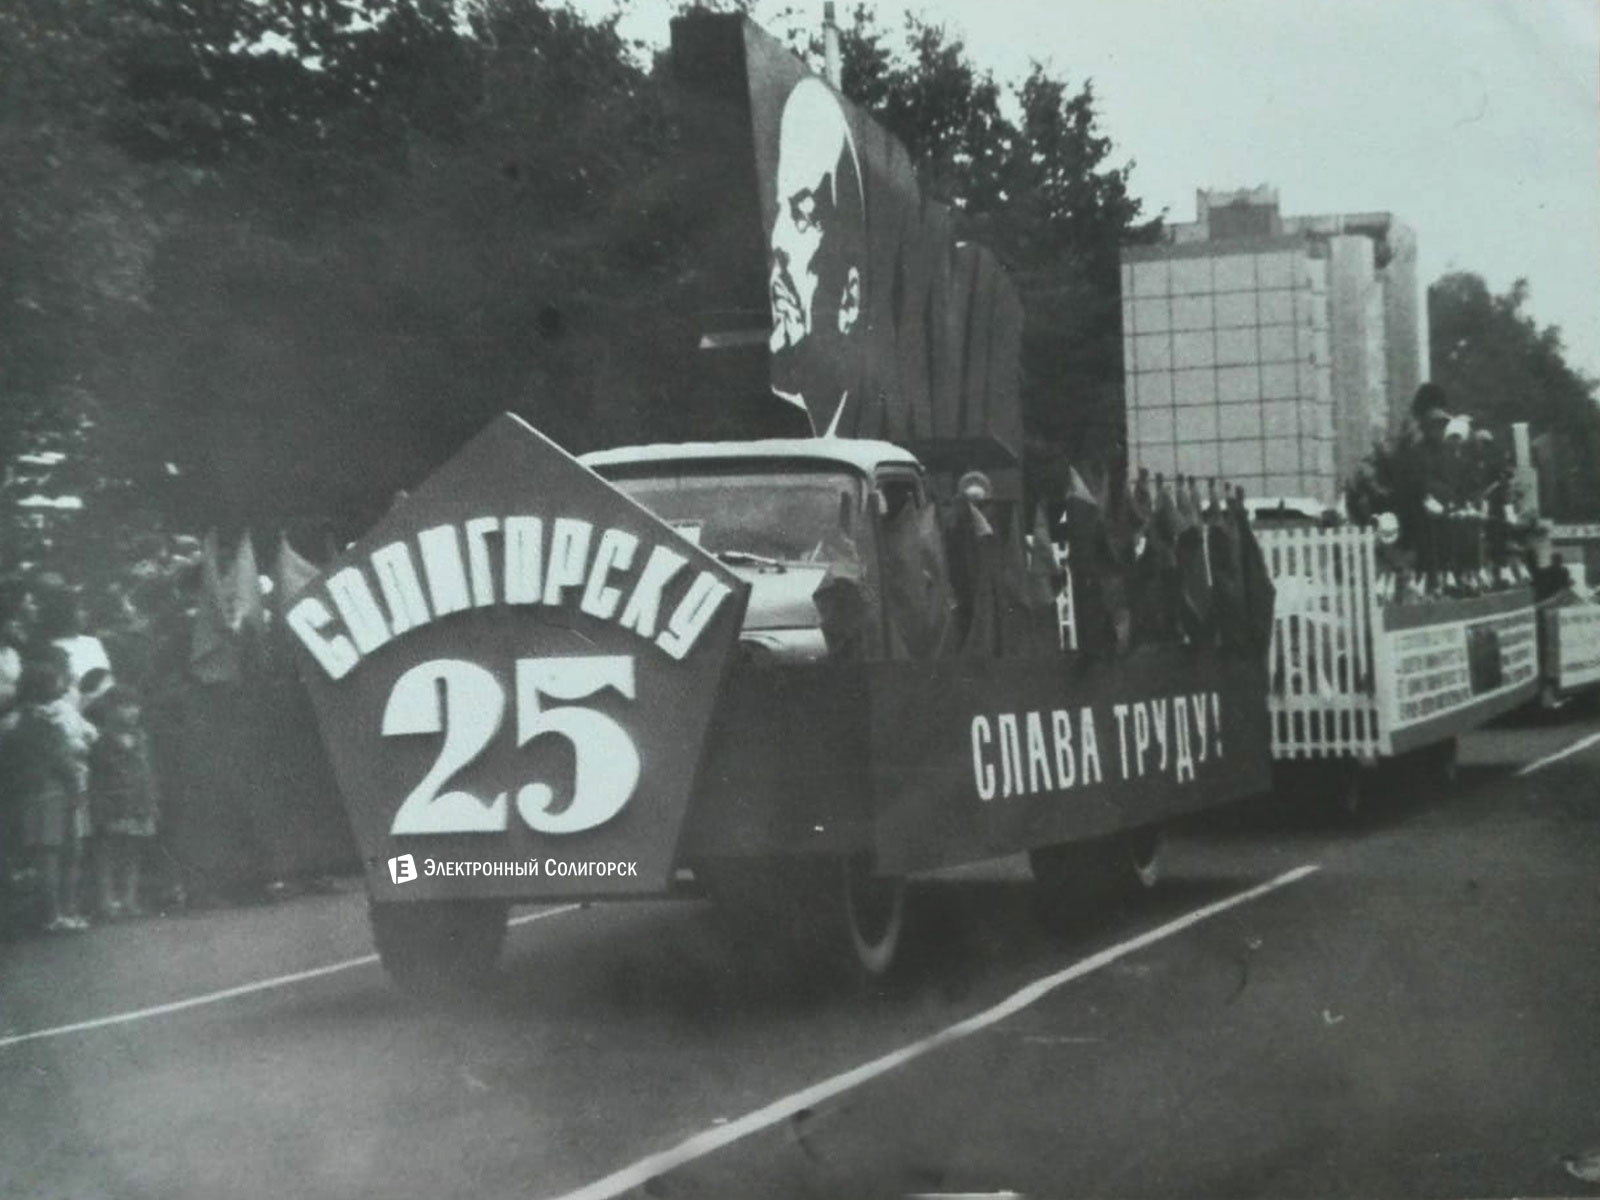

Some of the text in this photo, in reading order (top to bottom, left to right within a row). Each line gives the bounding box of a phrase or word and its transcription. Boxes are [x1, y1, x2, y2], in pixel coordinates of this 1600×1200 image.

[286, 516, 732, 680] СОЛИГОРСКУ
[382, 656, 639, 834] 25
[971, 692, 1222, 801] СЛАВА ТРУДУ!
